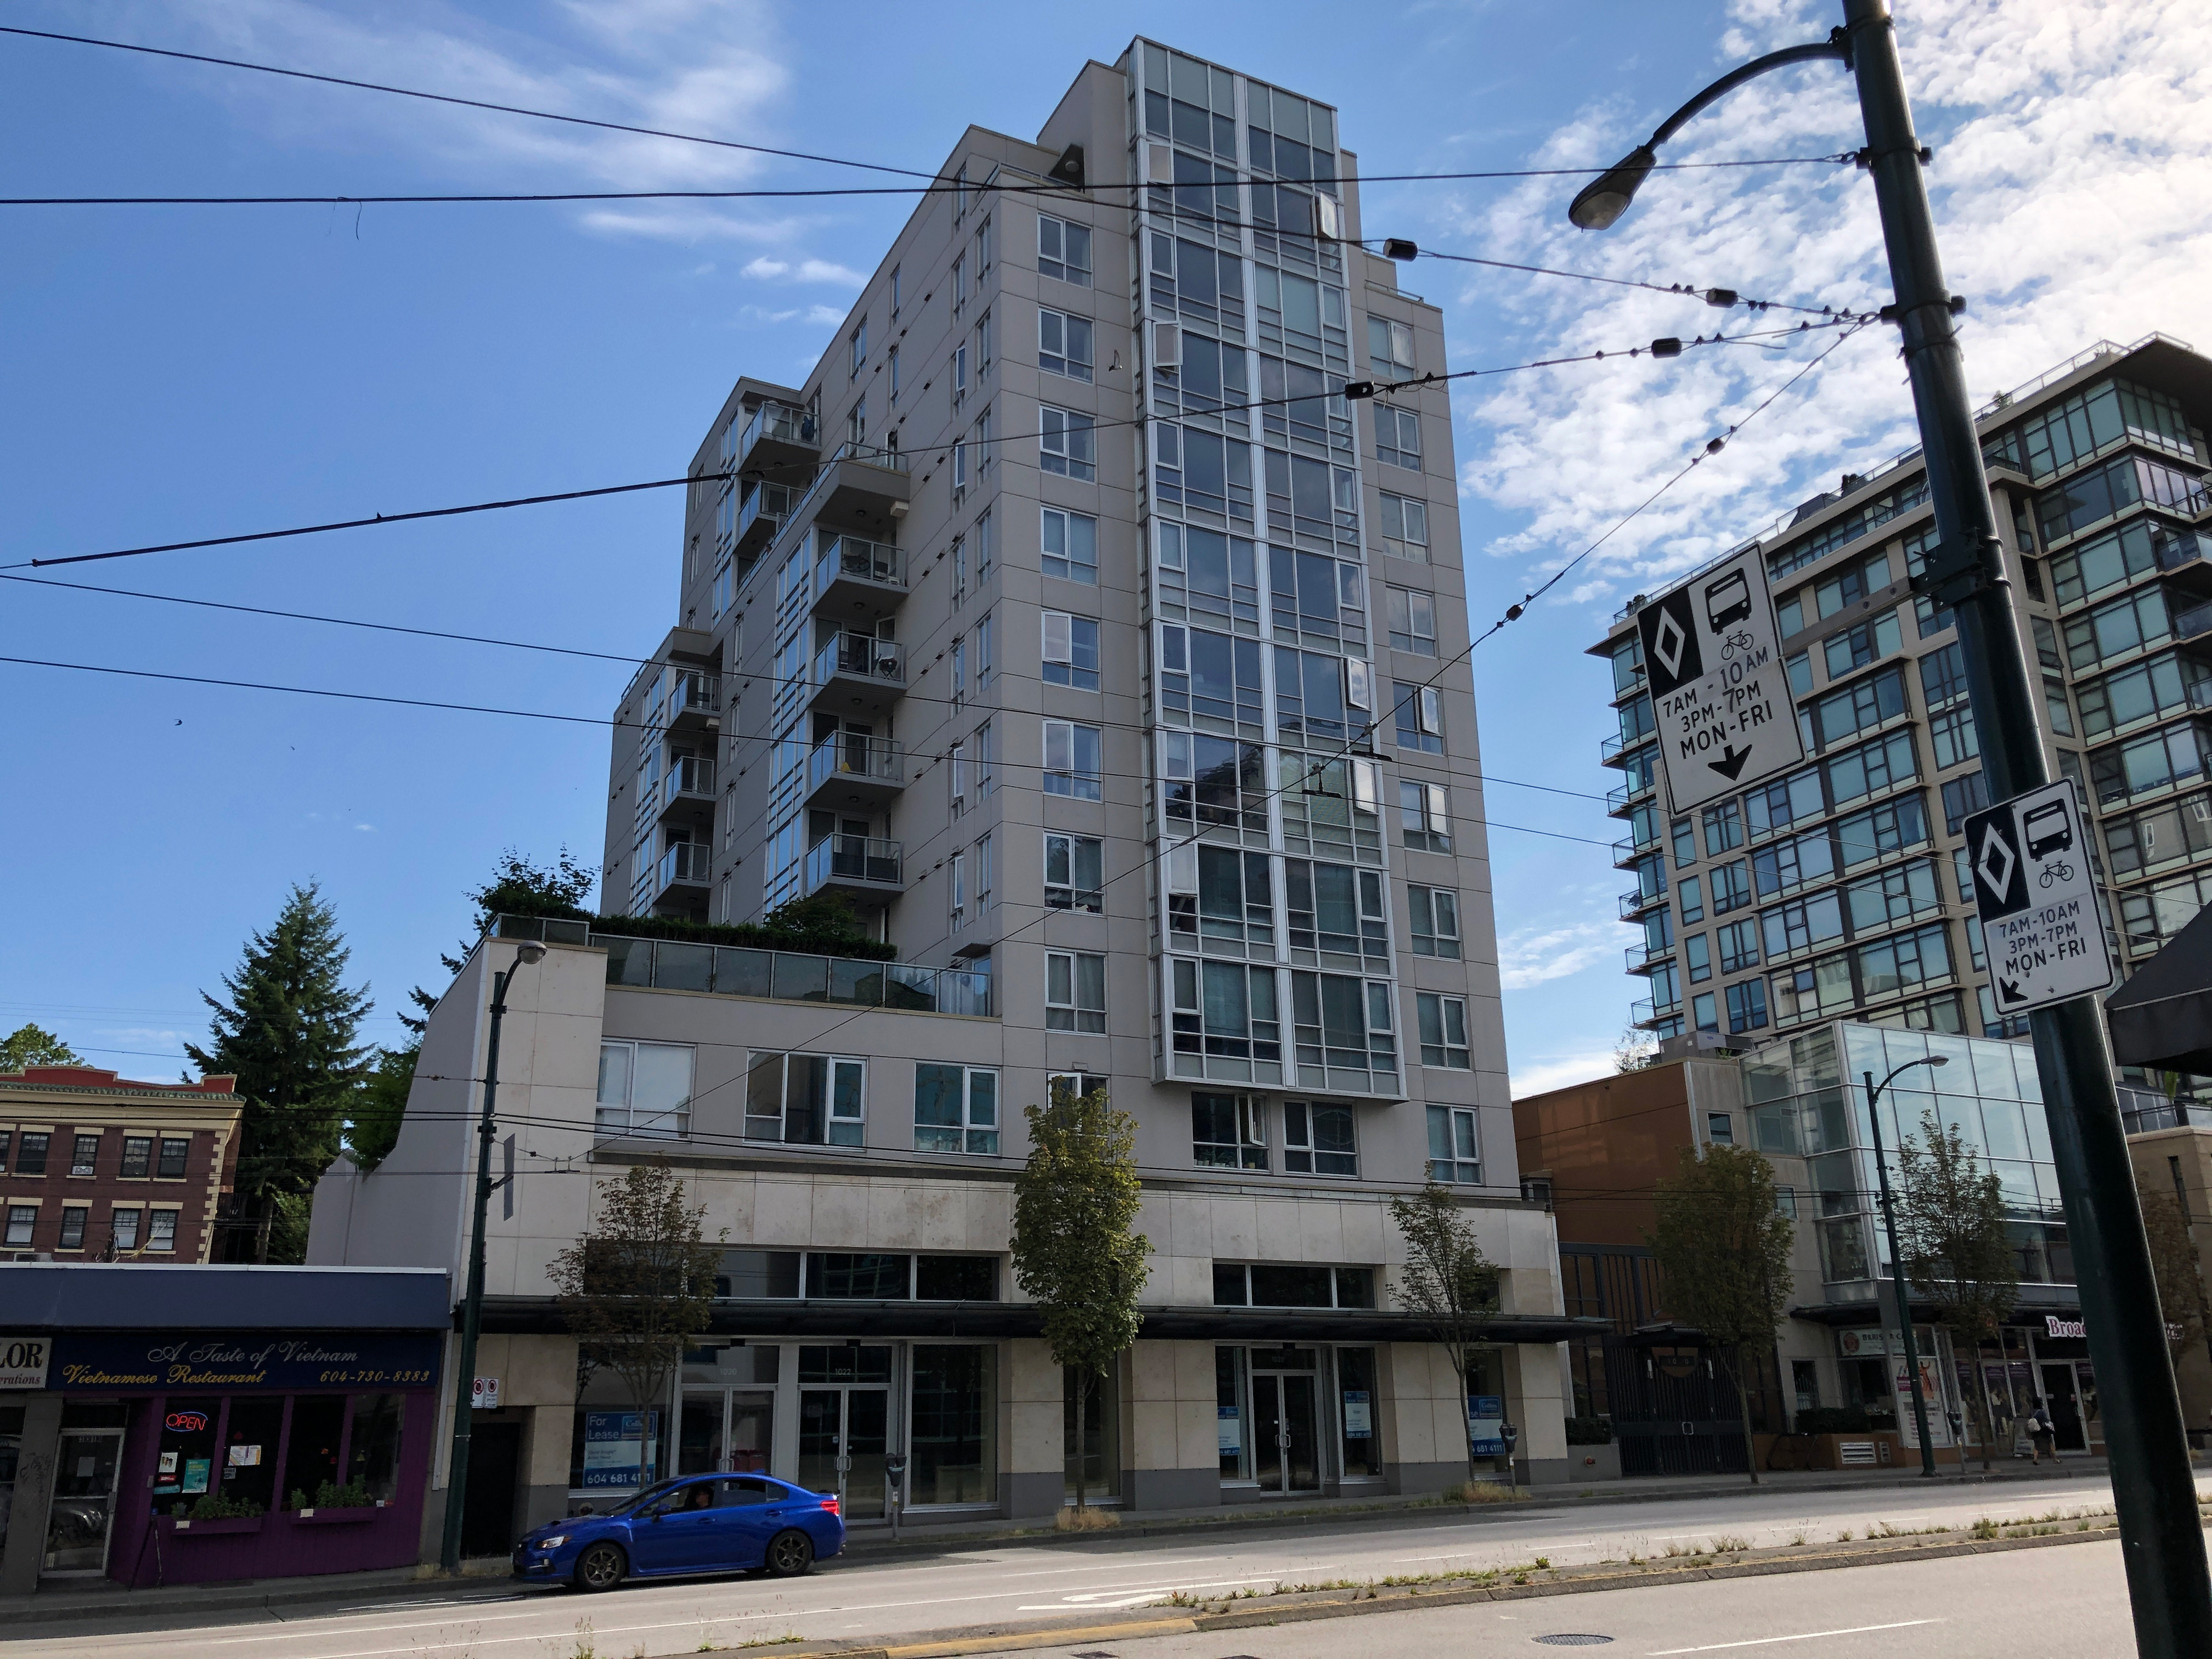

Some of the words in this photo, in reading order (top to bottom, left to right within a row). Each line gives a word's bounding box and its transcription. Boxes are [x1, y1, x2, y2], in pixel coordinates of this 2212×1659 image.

[1663, 688, 1697, 718] 7AM
[1681, 680, 1761, 732] 3PM-7PM
[1680, 700, 1773, 759] MON-FRI
[1999, 900, 2080, 938] 7AM-10AM
[2009, 922, 2078, 953] 3PM-7PM
[2006, 937, 2086, 975] MON-FRI
[148, 1341, 188, 1362] A
[189, 1342, 245, 1362] Taste
[250, 1342, 274, 1369] of
[279, 1340, 358, 1362] Vietnam
[63, 1364, 158, 1384] Vietnamese
[167, 1364, 267, 1384] Restaurant
[320, 1370, 430, 1383] 604-730-8383
[166, 1414, 206, 1431] OPEN
[589, 1430, 619, 1440] Lease
[590, 1416, 607, 1426] For
[587, 1474, 606, 1484] 604
[611, 1474, 628, 1483] 681
[631, 1473, 650, 1482] 411
